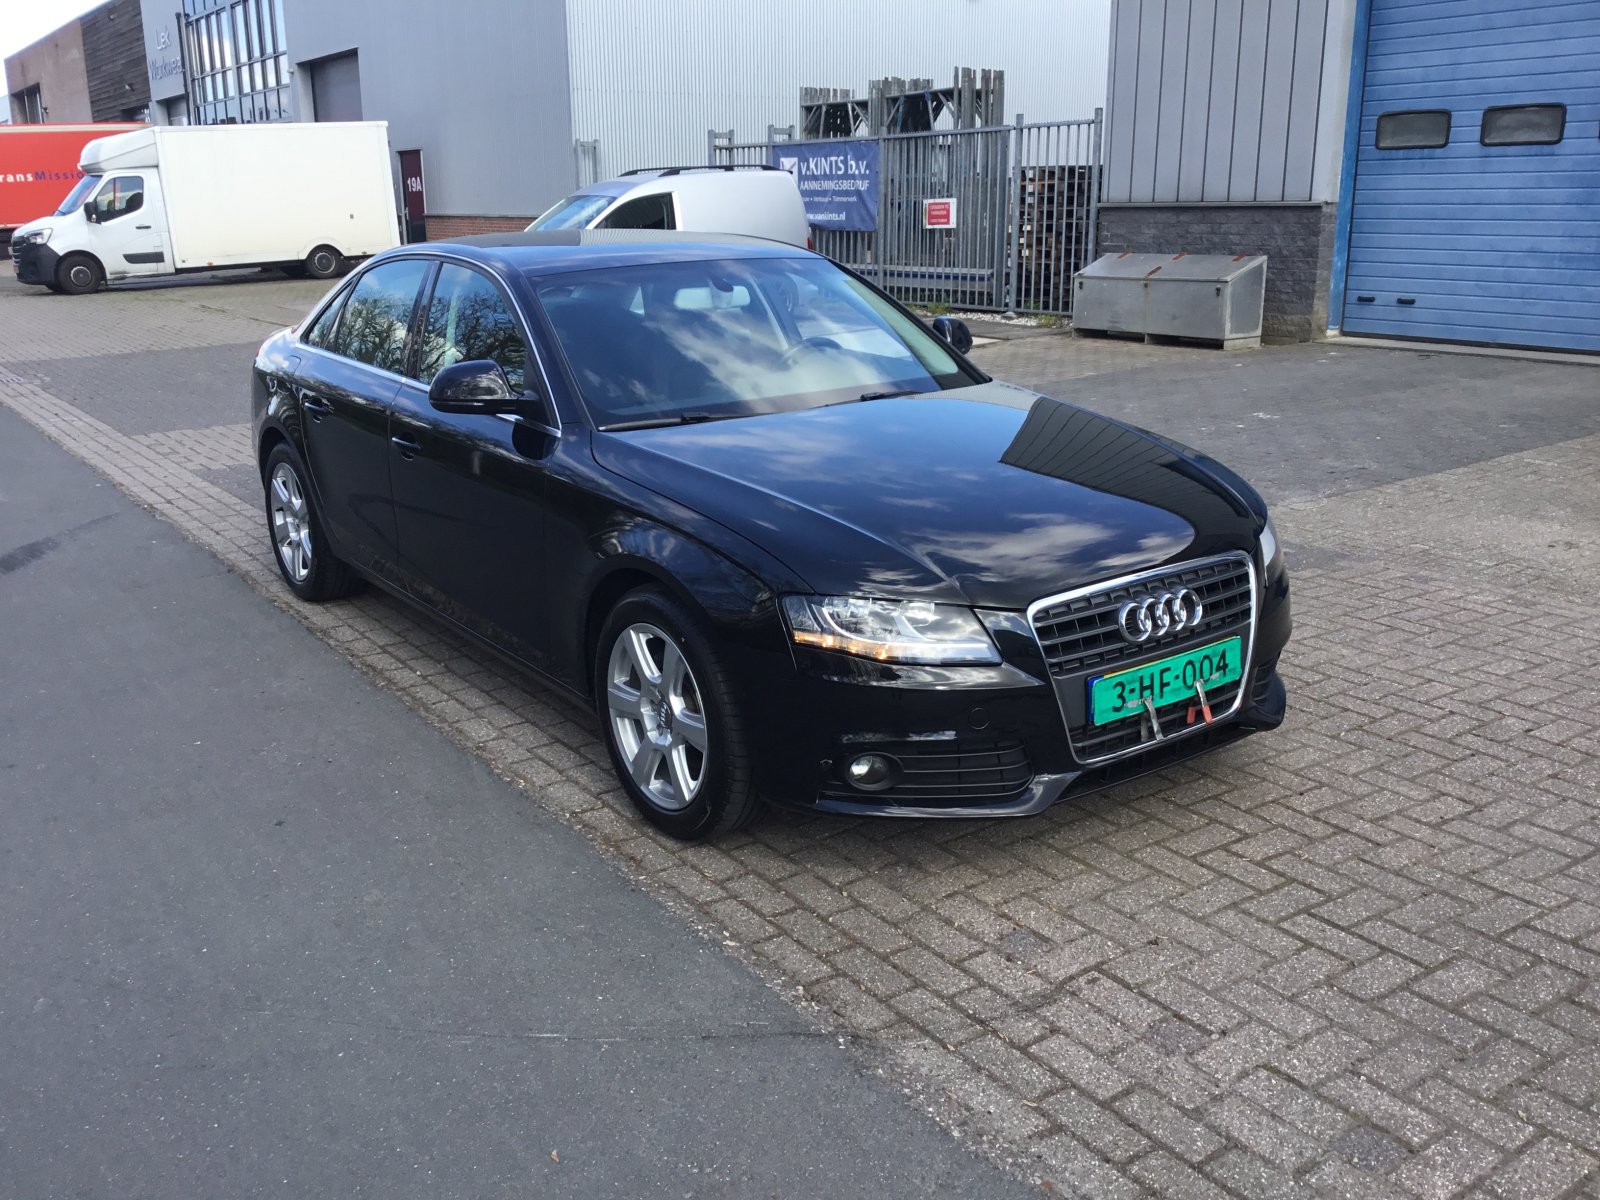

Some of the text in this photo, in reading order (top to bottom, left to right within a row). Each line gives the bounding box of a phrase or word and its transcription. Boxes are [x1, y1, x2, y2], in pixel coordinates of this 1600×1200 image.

[149, 56, 184, 80] Workwea
[801, 155, 870, 175] v.KINTS b.v.
[407, 176, 422, 191] 19A
[800, 180, 870, 190] AANNEMINGSBEDRIJF
[1111, 648, 1229, 713] 3-HF-004
